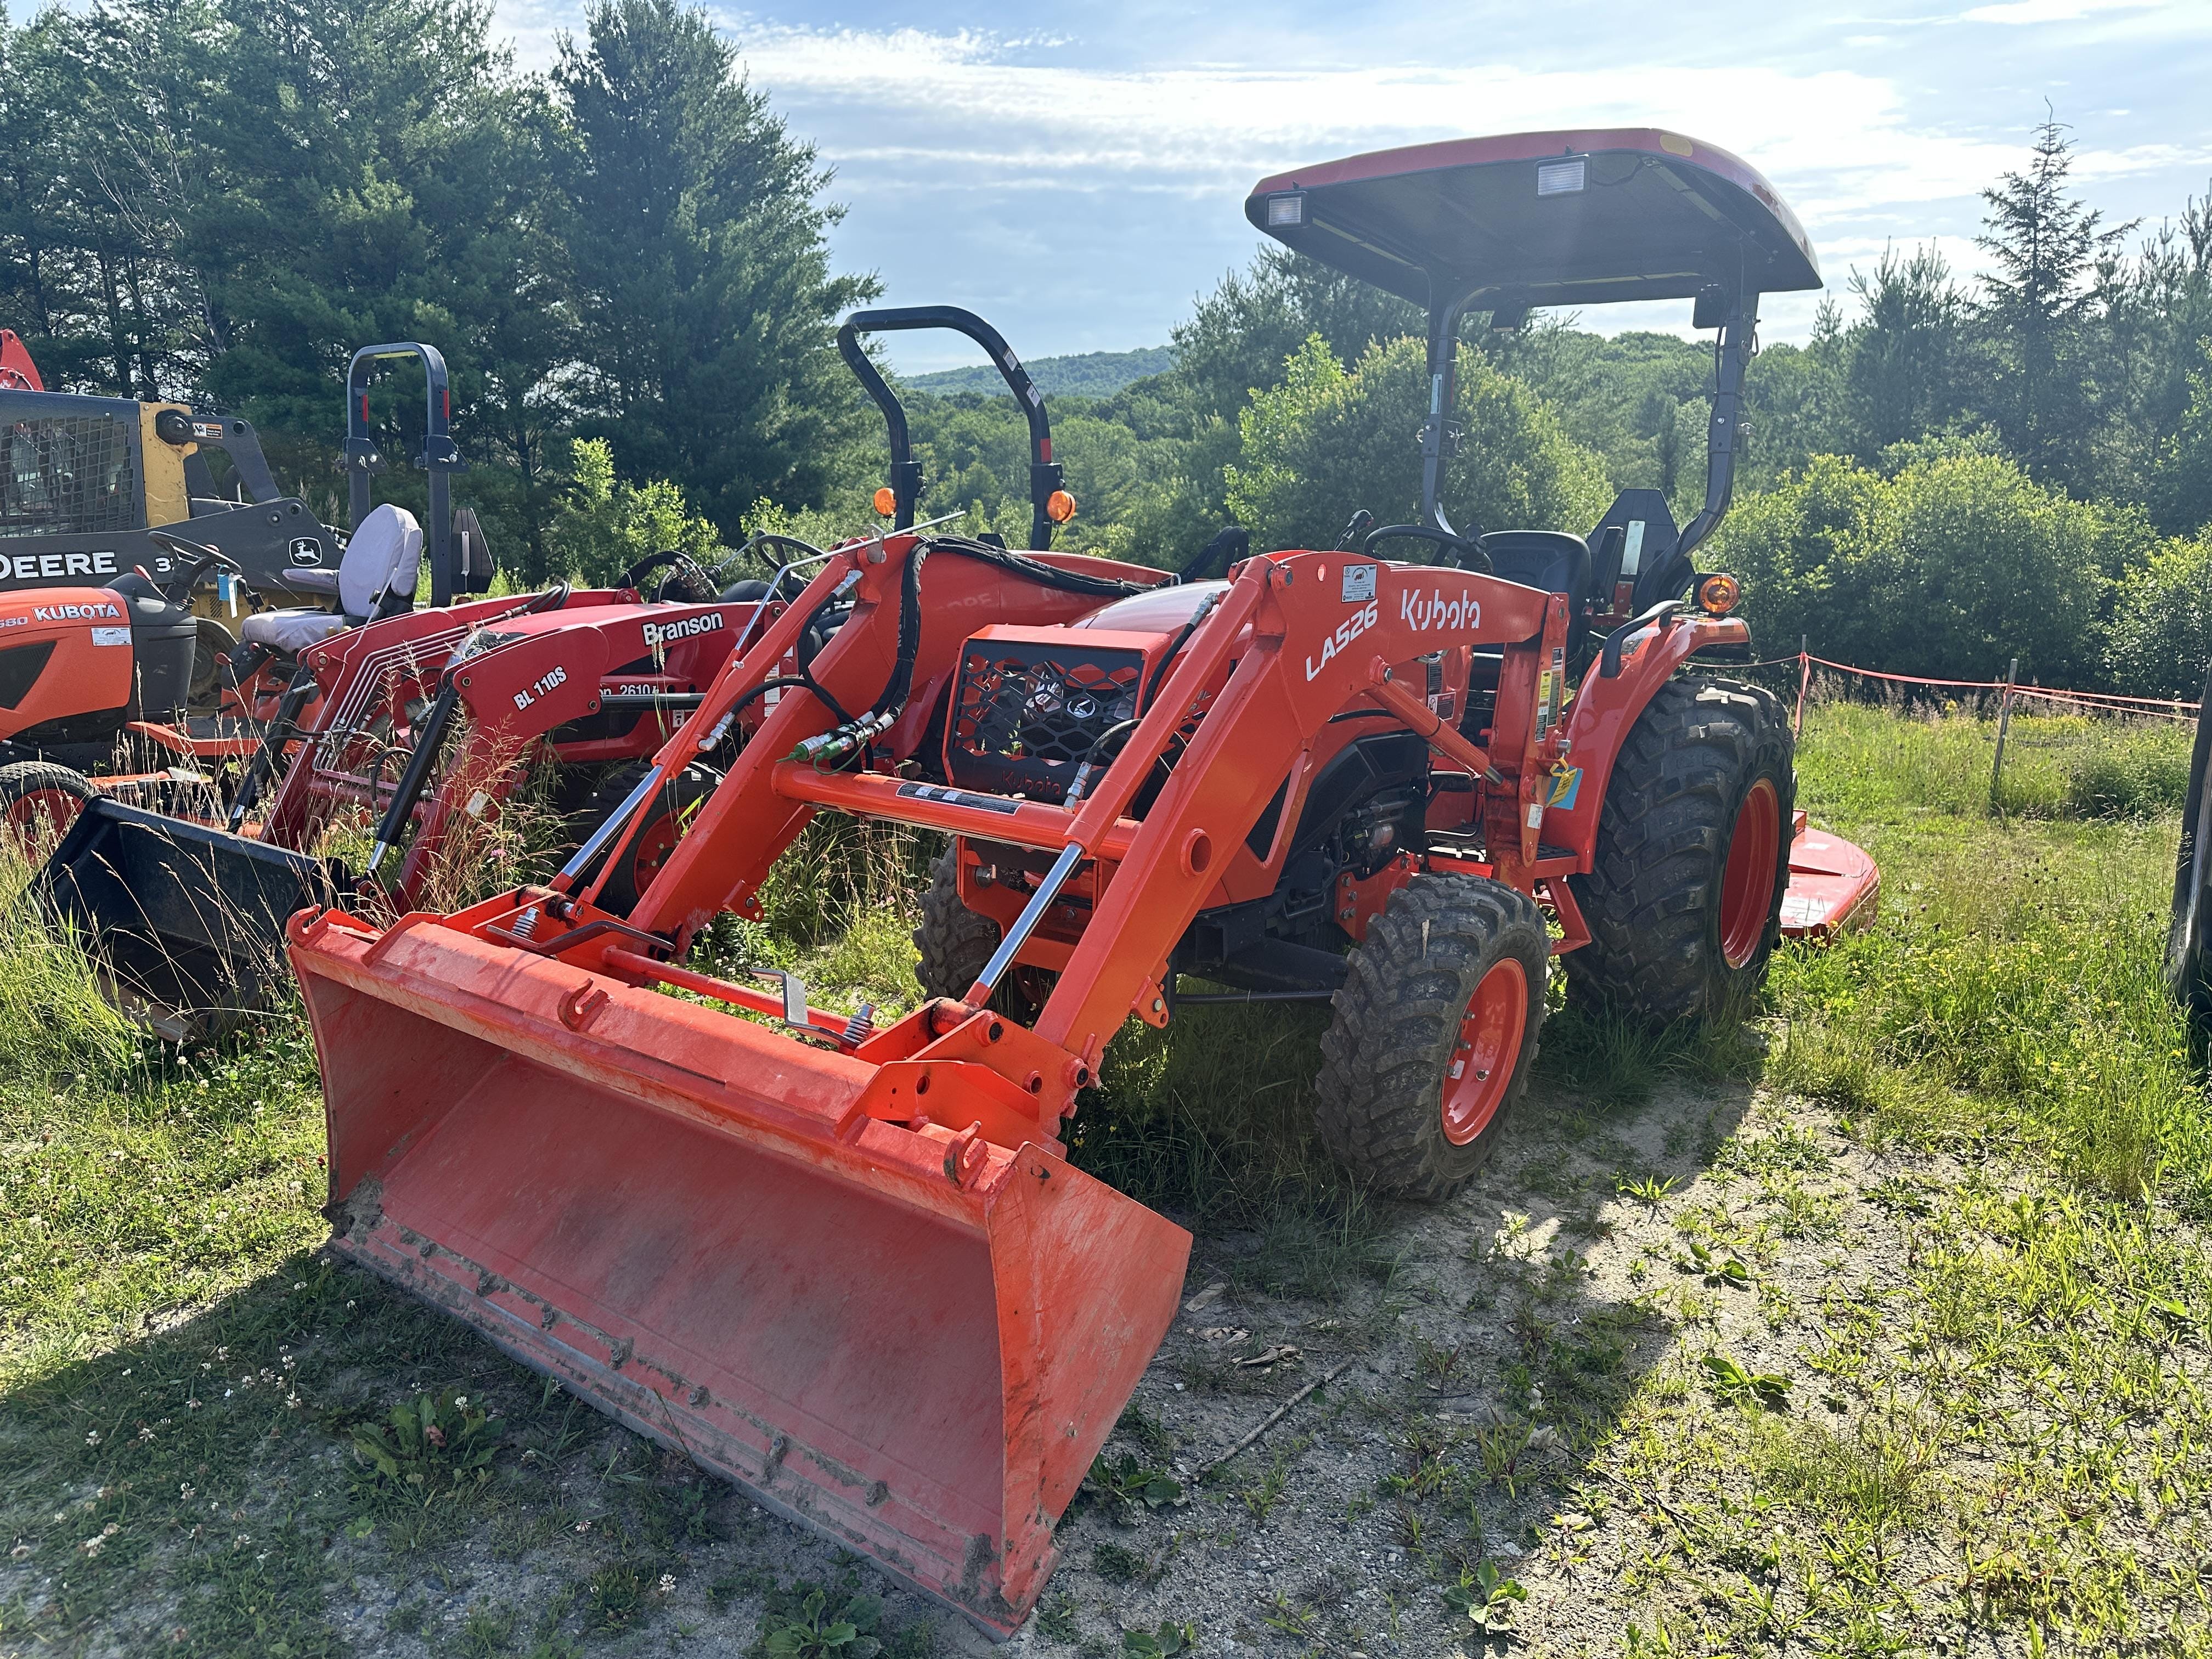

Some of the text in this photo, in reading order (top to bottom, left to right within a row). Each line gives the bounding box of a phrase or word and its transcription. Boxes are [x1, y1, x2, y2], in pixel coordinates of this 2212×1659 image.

[32, 603, 121, 622] KUBOTA
[642, 612, 724, 646] Branson
[1401, 589, 1480, 631] Kubota
[1305, 599, 1378, 681] LA526
[514, 665, 567, 710] BL 110S
[1002, 770, 1061, 795] Kubota
